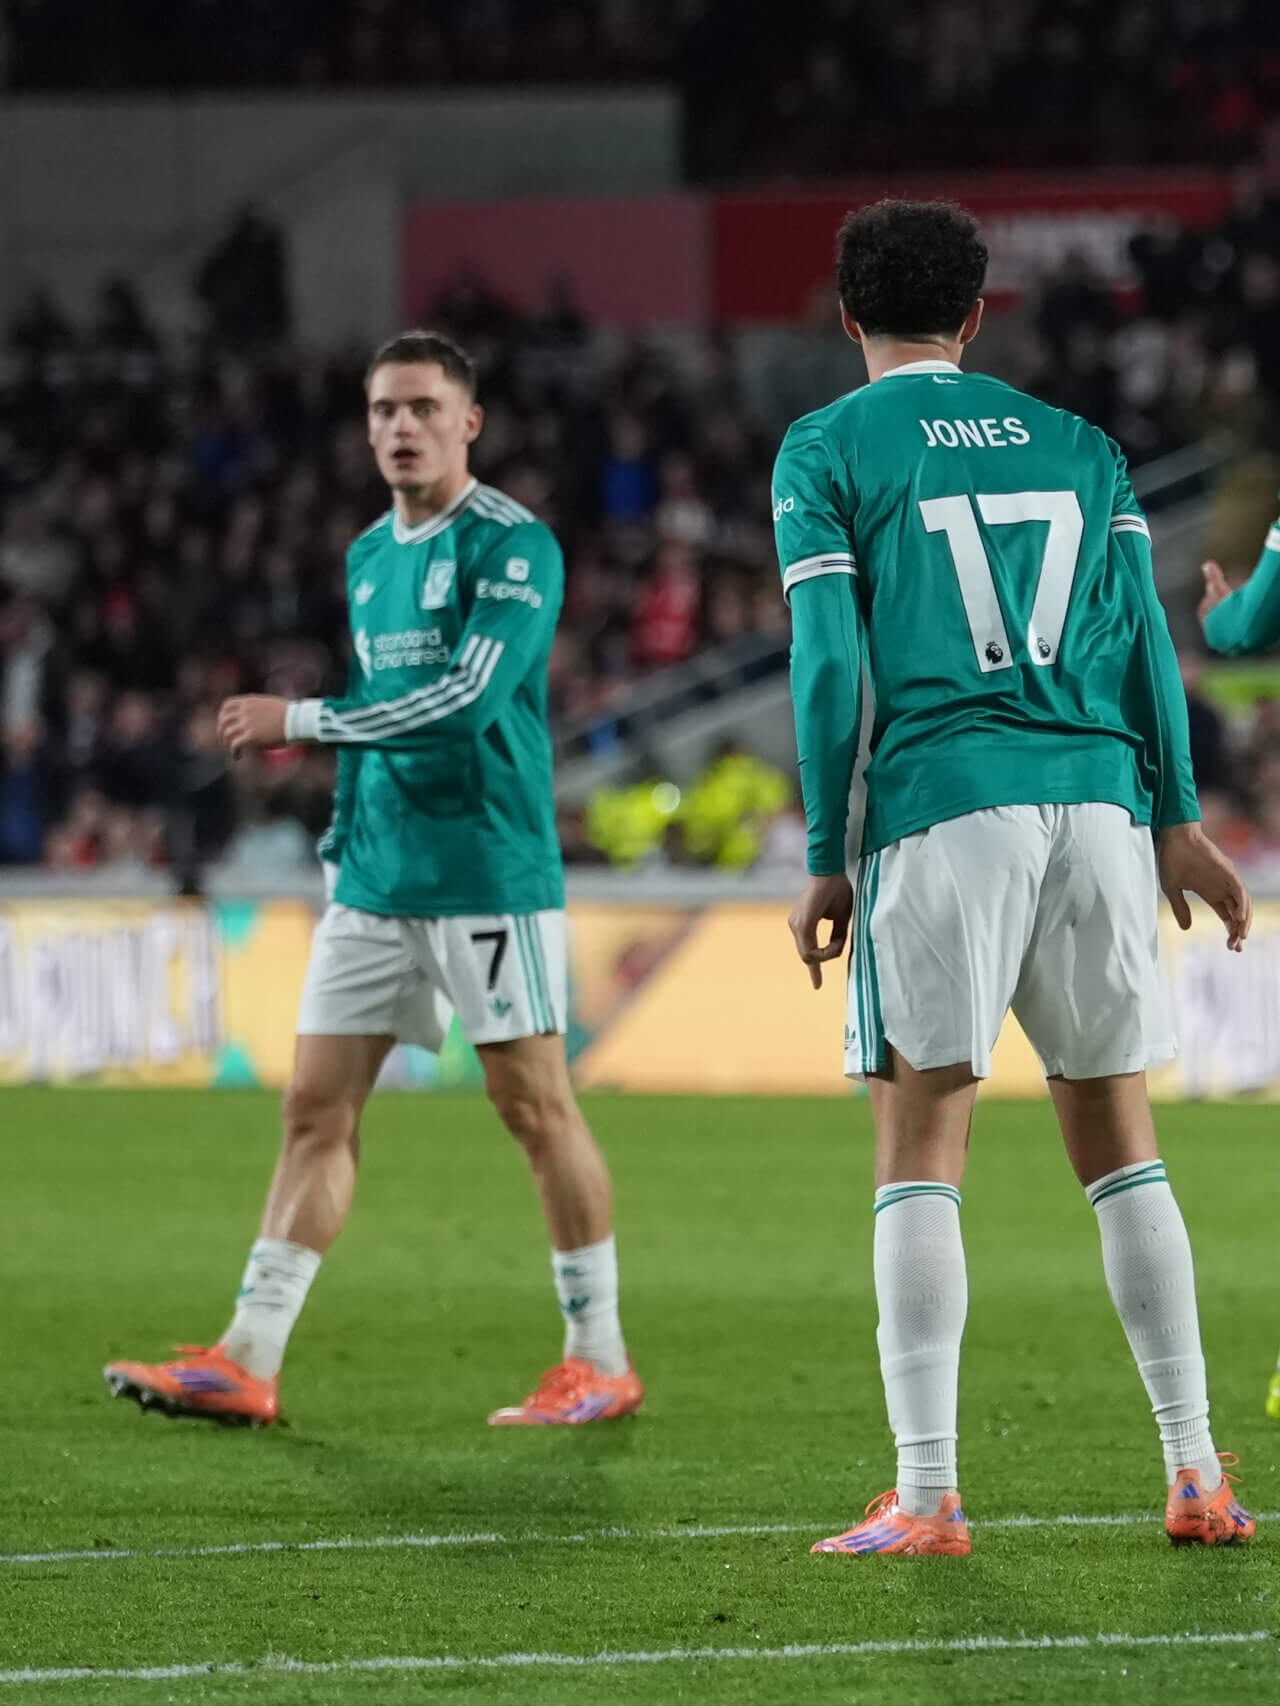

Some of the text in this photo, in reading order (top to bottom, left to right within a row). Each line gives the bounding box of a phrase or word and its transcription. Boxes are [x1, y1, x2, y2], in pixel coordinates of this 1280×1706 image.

[919, 417, 1031, 448] JONES
[918, 490, 1085, 673] 17
[470, 929, 508, 992] 7
